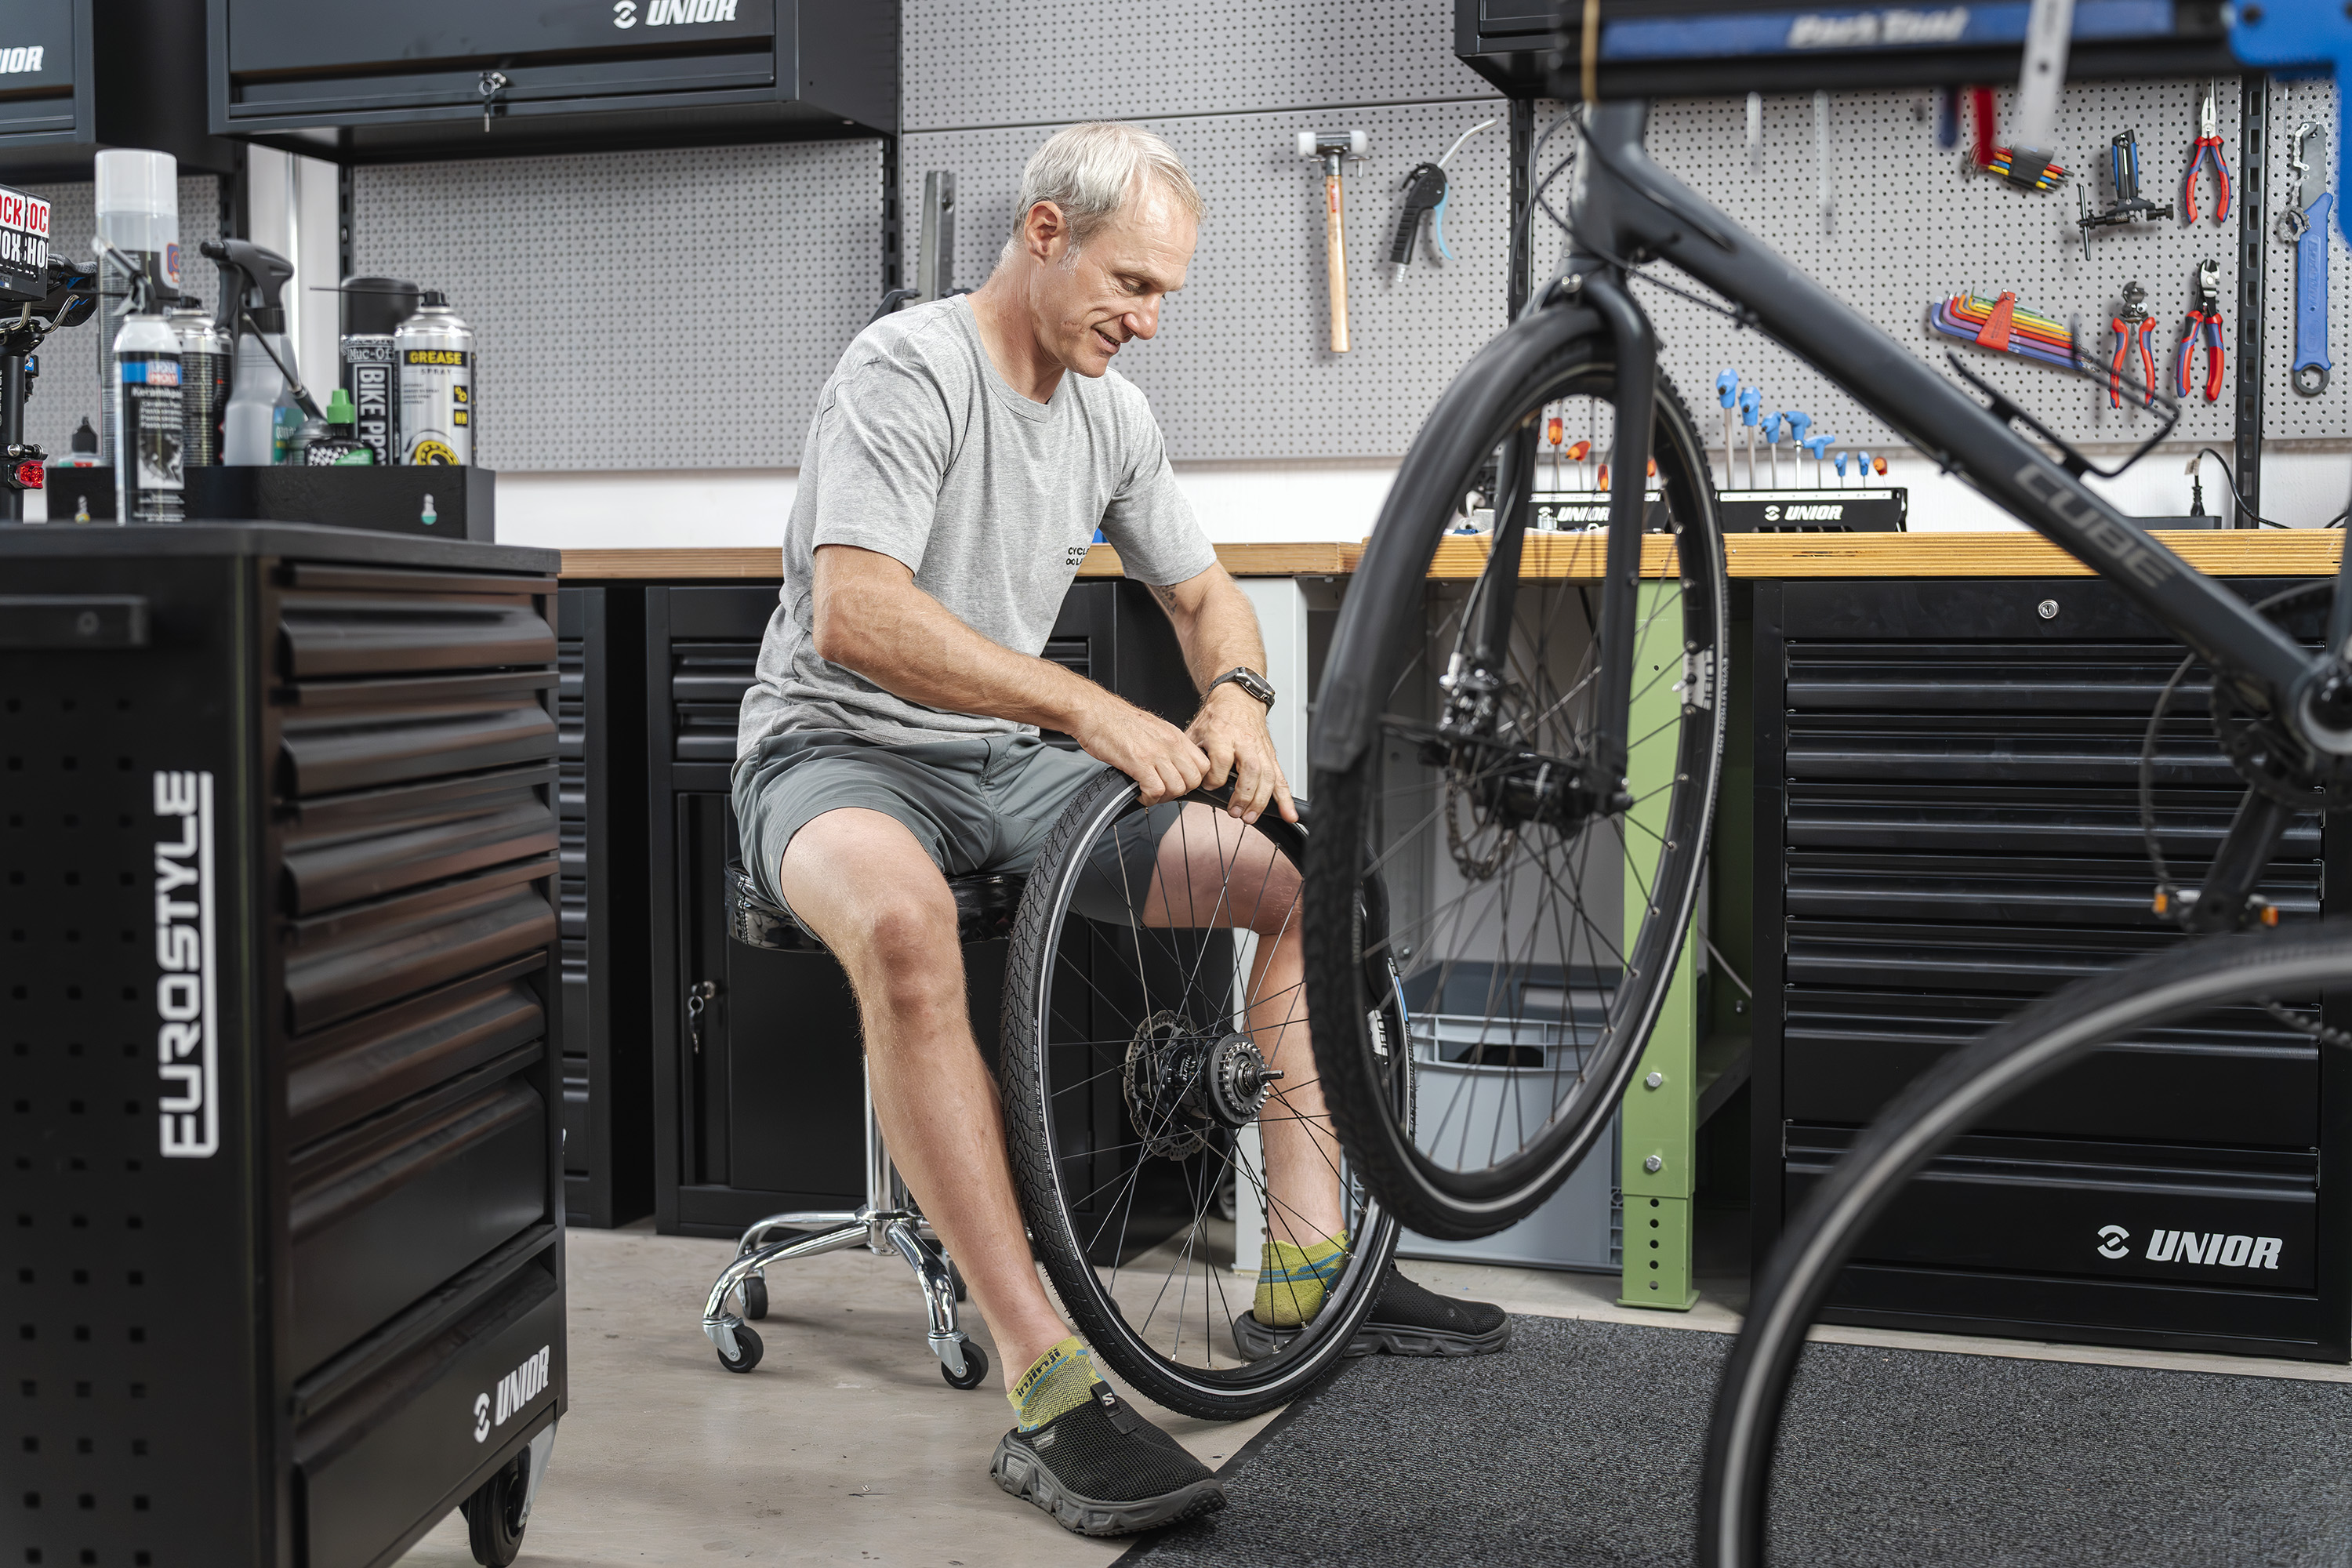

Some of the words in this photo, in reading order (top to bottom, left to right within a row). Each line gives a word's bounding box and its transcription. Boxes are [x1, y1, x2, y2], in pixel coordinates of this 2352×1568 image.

[645, 0, 739, 26] UNIOR
[0, 45, 44, 74] IOR
[0, 194, 22, 227] CK
[26, 202, 50, 234] OC
[0, 229, 21, 263] OX
[24, 237, 49, 269] HO
[409, 350, 463, 365] GREASE
[359, 369, 386, 416] BIKE
[361, 421, 387, 465] PR
[1556, 506, 1611, 521] UNIOR
[1784, 504, 1844, 521] UNIOR
[2014, 462, 2177, 588] CUBE
[154, 771, 219, 1158] EUROSTYLE
[2145, 1229, 2283, 1269] UNIOR
[495, 1344, 550, 1426] UNIOR
[1015, 1348, 1061, 1398] injinji
